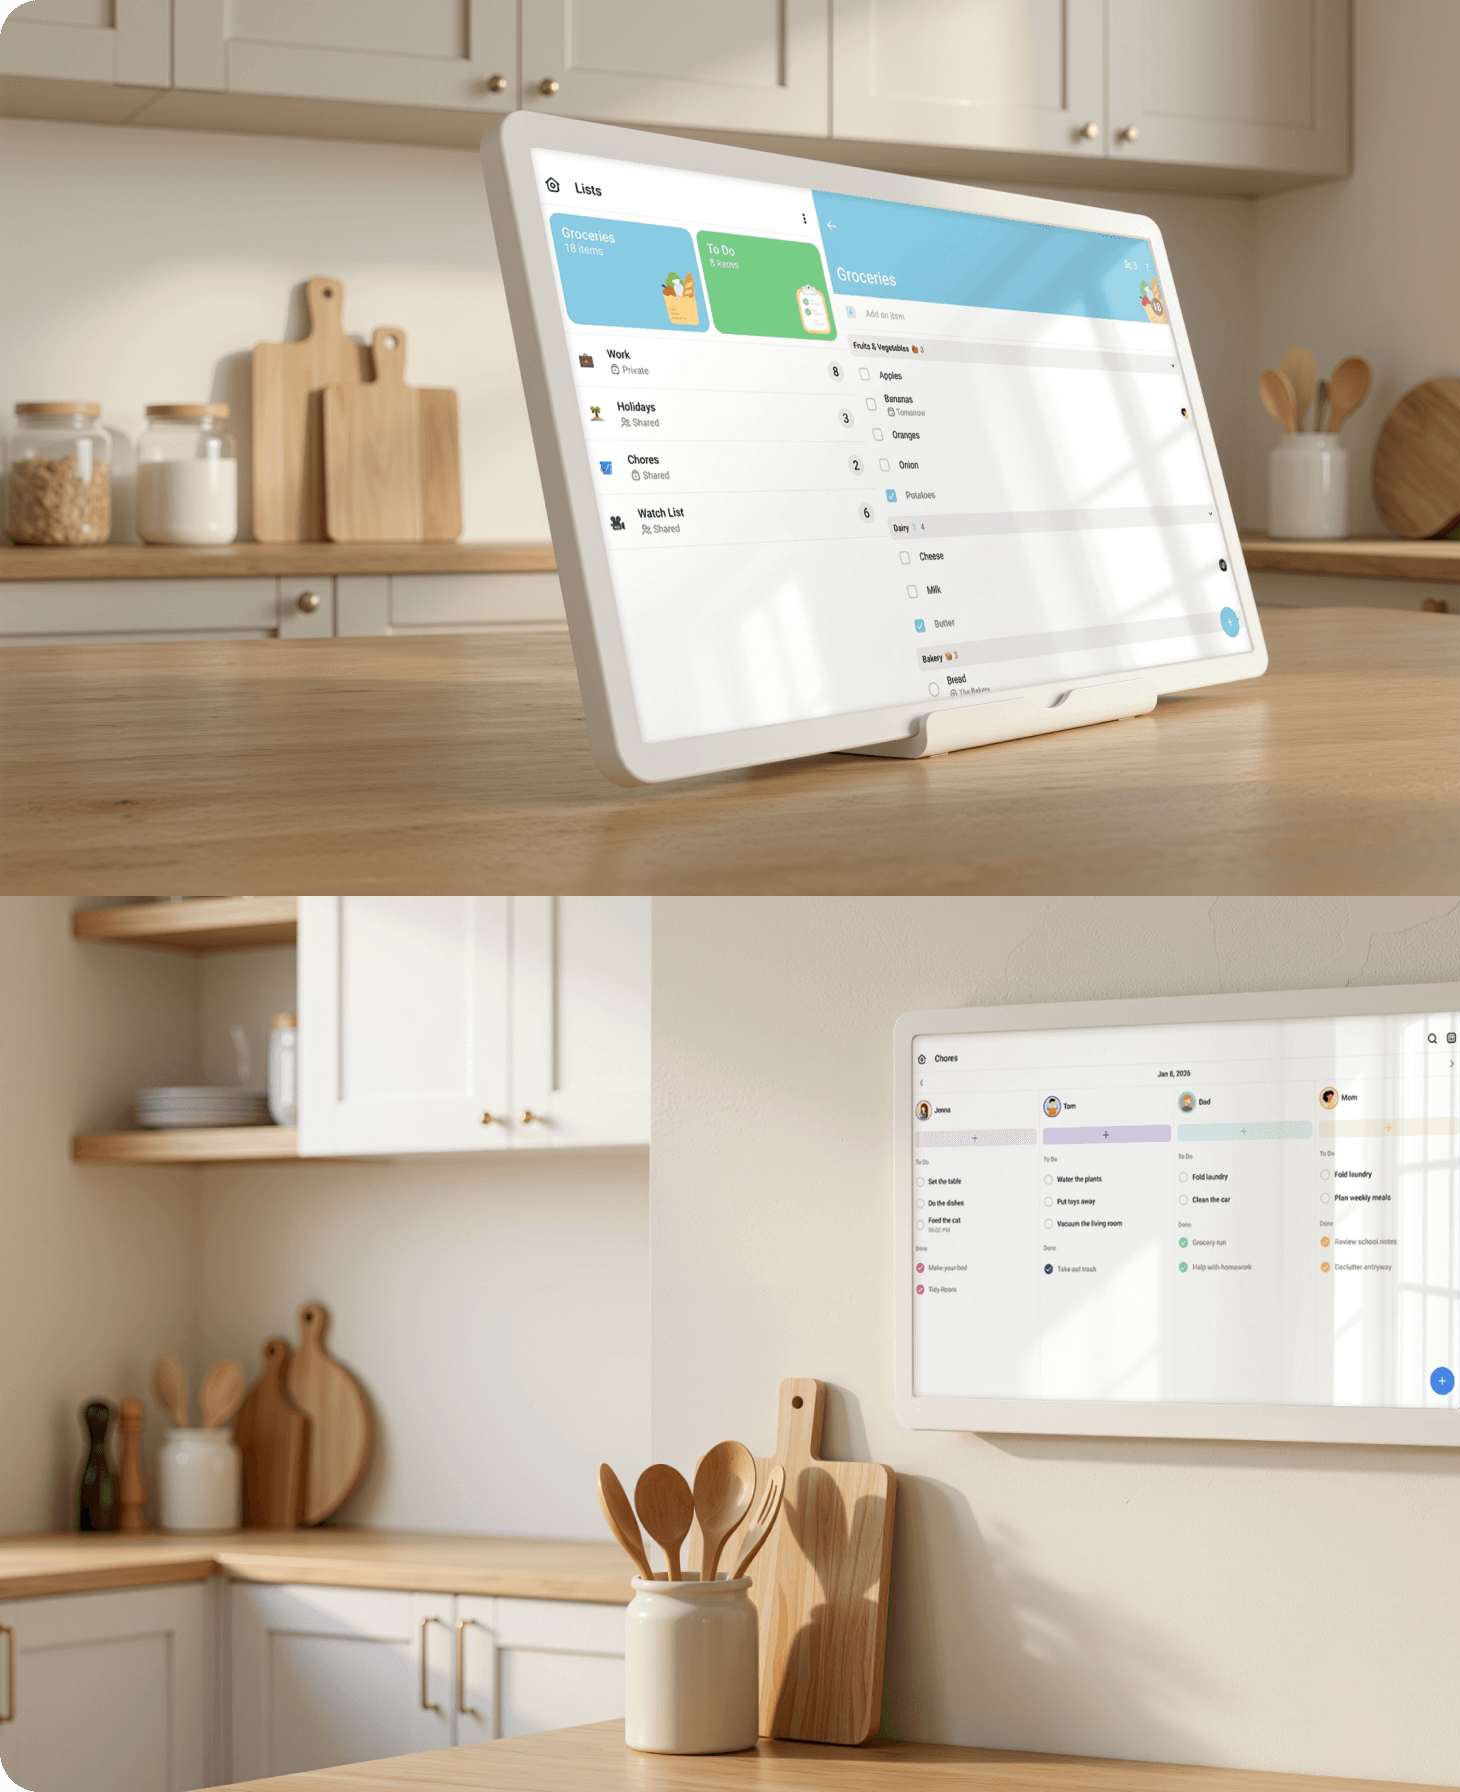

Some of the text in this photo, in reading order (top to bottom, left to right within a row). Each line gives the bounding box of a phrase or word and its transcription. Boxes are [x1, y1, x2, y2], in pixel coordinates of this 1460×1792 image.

[575, 183, 602, 196] Lists
[561, 227, 615, 244] Groceries
[565, 244, 603, 256] 18 items
[706, 244, 735, 256] To Do
[837, 267, 897, 286] Groceries
[866, 310, 879, 318] Add
[853, 342, 870, 351] Fruits
[607, 350, 630, 359] Work
[622, 366, 649, 375] Private
[832, 367, 839, 377] 8
[880, 371, 902, 381] Apples
[884, 395, 913, 403] Bananas
[617, 402, 656, 413] Holidays
[896, 408, 925, 416] Tomorrow
[632, 418, 659, 427] Shared
[842, 413, 849, 424] 3
[892, 431, 920, 441] Oranges
[628, 455, 659, 465] Chores
[853, 460, 860, 470] 2
[899, 461, 919, 469] Onion
[643, 471, 670, 480] Shared
[638, 508, 684, 519] Watch List
[864, 508, 870, 518] 6
[653, 524, 680, 533] Shared
[894, 525, 909, 533] Dairy
[919, 552, 944, 561] Cheese
[927, 585, 941, 594] Milk
[922, 653, 943, 663] Bakery
[947, 674, 966, 685] Bread
[934, 1054, 958, 1063] Chores
[1199, 1098, 1210, 1106] Dad
[1349, 1171, 1372, 1179] laundry
[948, 1177, 961, 1185] table
[1085, 1176, 1102, 1184] plants
[1350, 1194, 1370, 1202] weekly
[1068, 1199, 1079, 1207] toys
[1091, 1220, 1106, 1228] living
